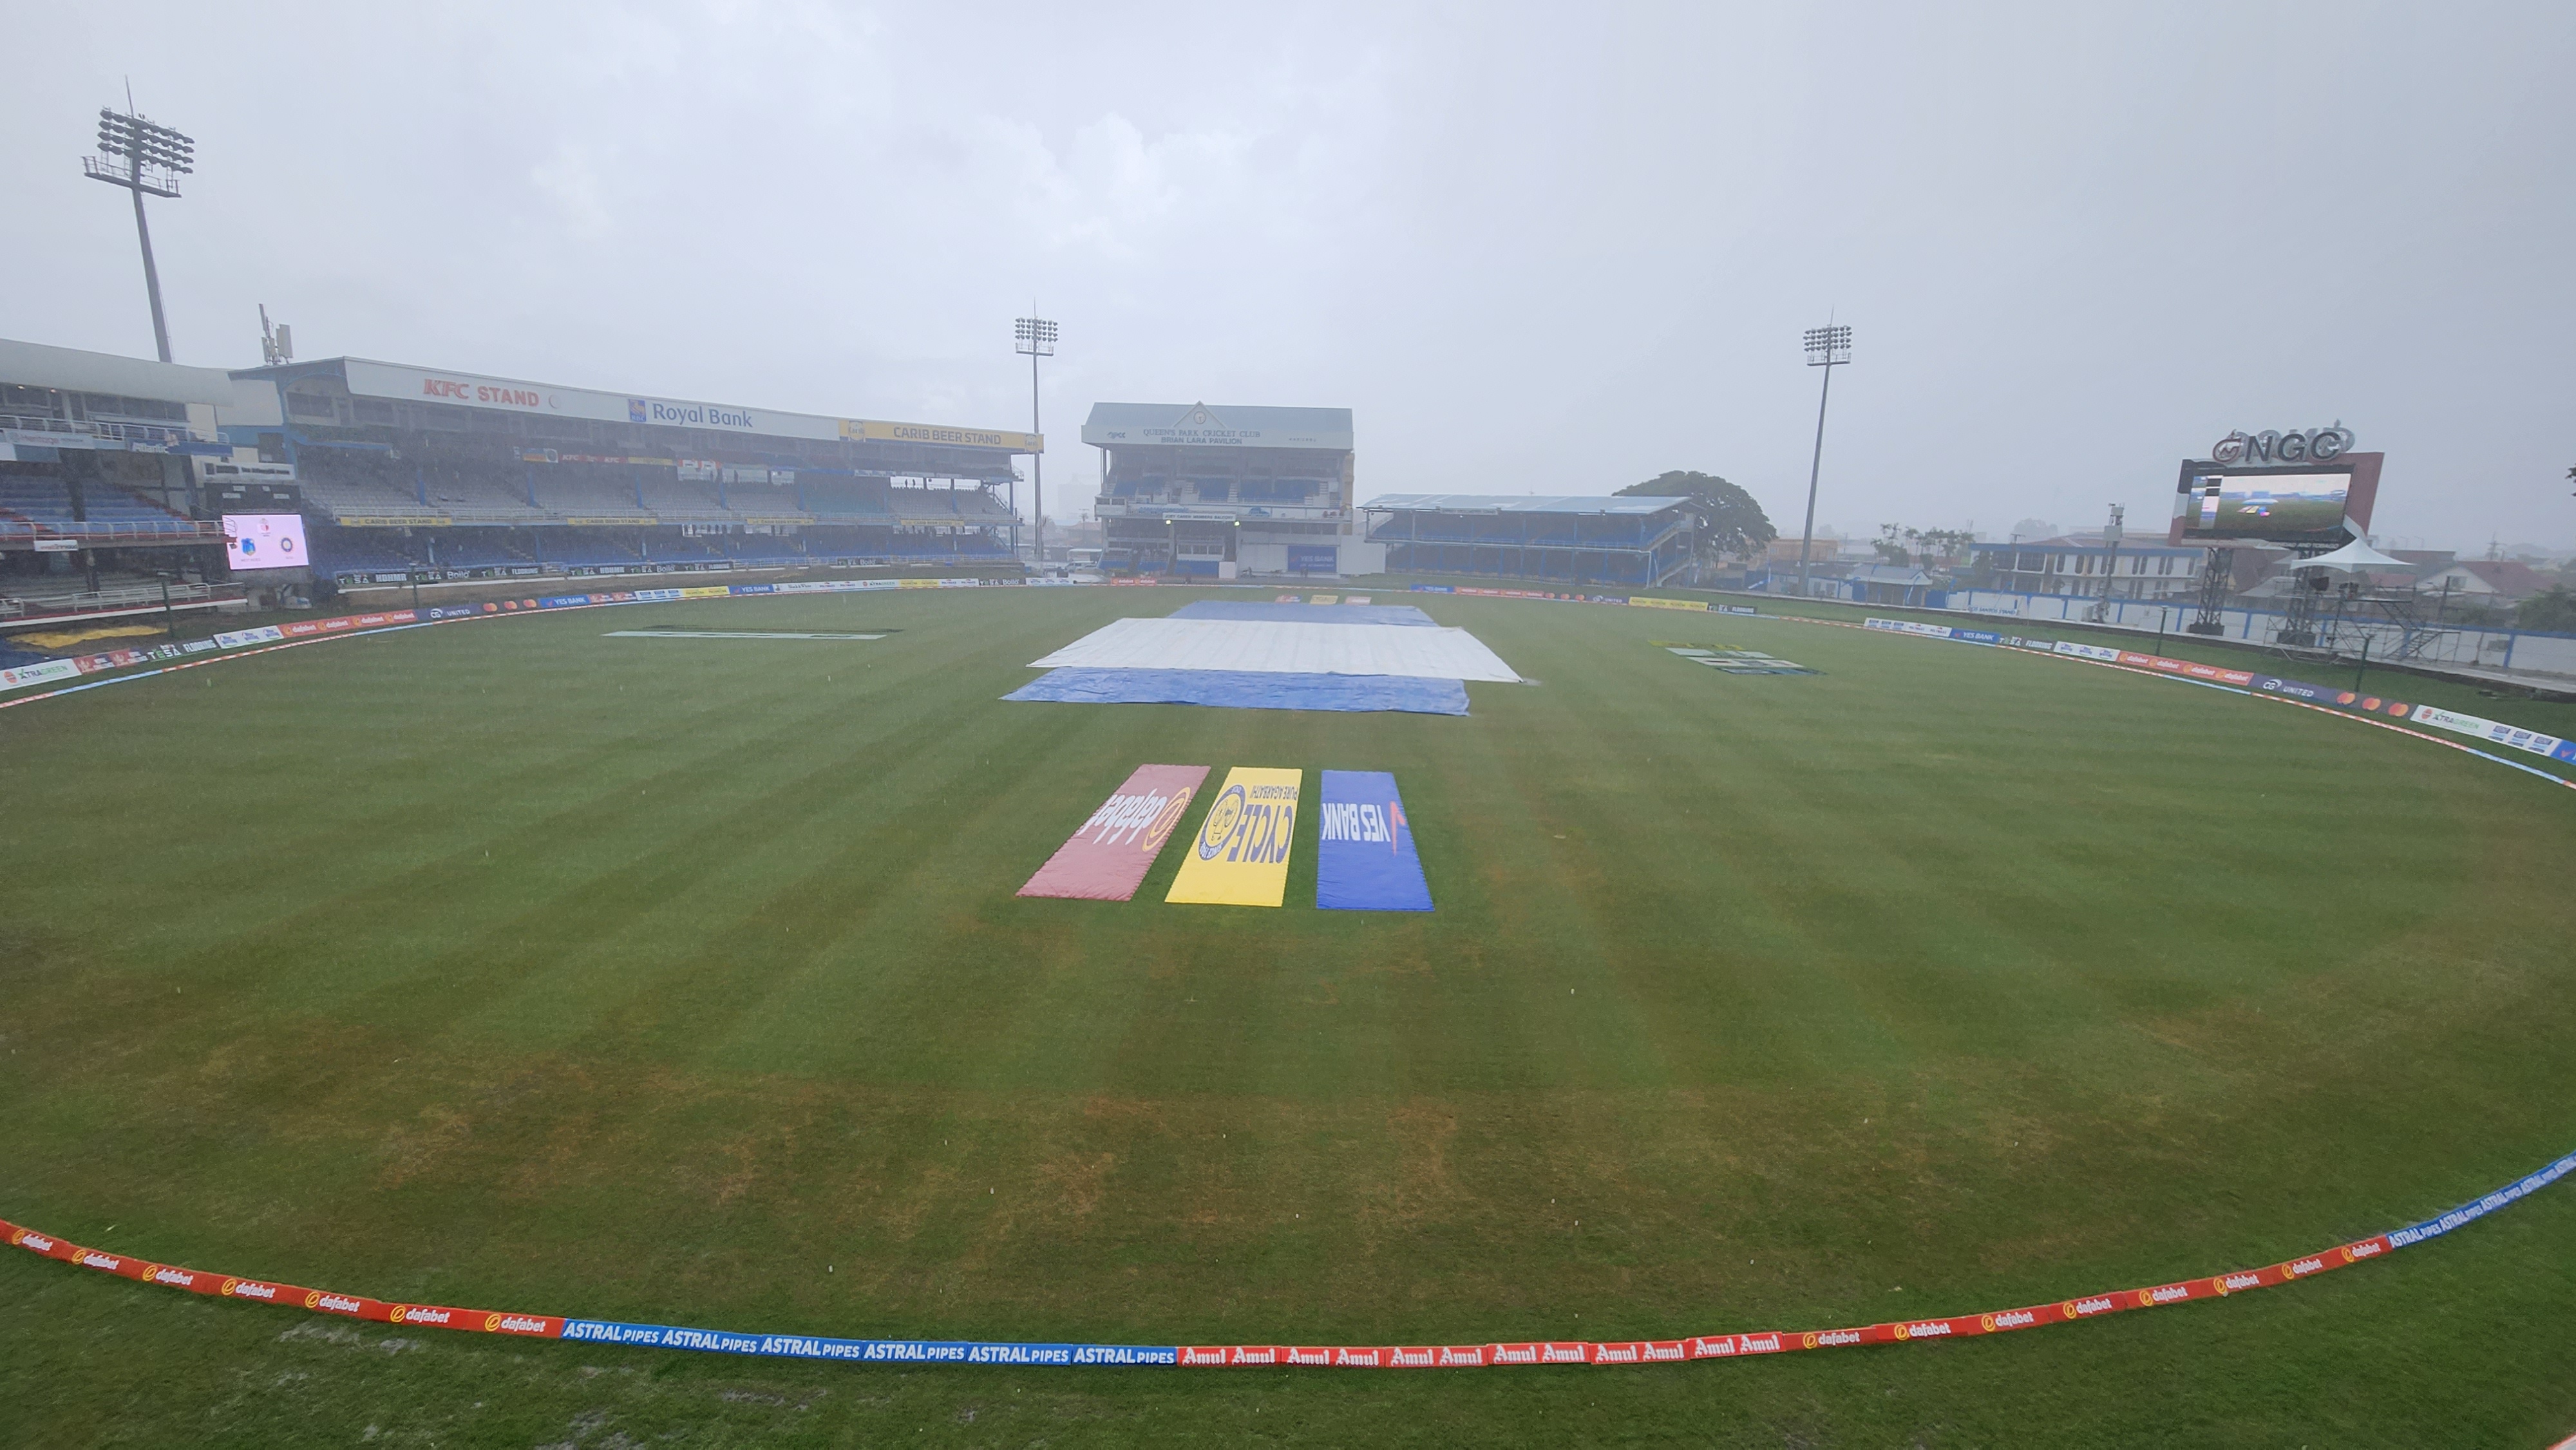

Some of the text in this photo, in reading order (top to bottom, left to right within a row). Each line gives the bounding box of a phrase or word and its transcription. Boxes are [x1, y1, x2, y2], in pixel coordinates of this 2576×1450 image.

[423, 378, 540, 407] KFC STAND
[652, 402, 753, 428] Royal Bank
[893, 426, 1001, 445] CARIB BEER STAND
[1143, 428, 1175, 437] QUEEN'S
[1202, 429, 1236, 438] CRICKET
[375, 573, 407, 583] HDHMR
[554, 597, 567, 605] YES
[326, 620, 348, 629] dafabet
[361, 616, 384, 625] dafabet
[393, 612, 415, 621] dafabet
[292, 625, 316, 634] dafabet
[1975, 632, 1995, 641] BANK
[183, 639, 216, 653] FLOORING
[2127, 655, 2149, 664] dafabet
[2157, 659, 2179, 669] dafabet
[18, 664, 68, 680] XTRAGREEN
[2192, 666, 2215, 676] dafabet
[2224, 672, 2249, 682] dafabet
[2263, 680, 2314, 697] CG UNITED
[2432, 711, 2479, 730] XTRAGREEN
[1250, 785, 1298, 801] PURE AGARBATHI
[1076, 788, 1167, 845] dafabet
[1322, 803, 1391, 842] YES BANK
[1226, 804, 1293, 863] CYCLE
[2520, 1174, 2545, 1194] ASTRAL
[2481, 1192, 2508, 1211] ASTRAL
[2439, 1211, 2468, 1231] ASTRAL
[23, 1234, 53, 1251] dafabet
[2389, 1228, 2423, 1248] ASTRAL
[2352, 1243, 2381, 1257] dafabet
[84, 1253, 119, 1270] dafabet
[2293, 1259, 2323, 1275] dafabet
[156, 1268, 193, 1286] dafabet
[2226, 1274, 2259, 1289] dafabet
[236, 1282, 276, 1299] dafabet
[2152, 1286, 2188, 1302] dafabet
[319, 1294, 361, 1312] dafabet
[2076, 1298, 2112, 1314] dafabet
[406, 1308, 450, 1324] dafabet
[501, 1316, 545, 1333] dafabet
[1996, 1312, 2034, 1327] dafabet
[563, 1322, 659, 1344] ASTRAL PIPES
[1909, 1322, 1951, 1337] dafabet
[661, 1330, 757, 1353] ASTRAL PIPES
[1694, 1337, 1735, 1358] Amul
[1739, 1333, 1781, 1354] Amul
[1818, 1332, 1860, 1346] dafabet
[761, 1337, 860, 1359] ASTRAL PIPES
[864, 1343, 965, 1360] ASTRAL PIPES
[968, 1346, 1069, 1363] ASTRAL PIPES
[1073, 1346, 1175, 1364] ASTRAL PIPES
[1182, 1346, 1226, 1366] Amul
[1232, 1346, 1276, 1365] Amul
[1287, 1347, 1330, 1366] Amul
[1336, 1347, 1379, 1366] Amul
[1390, 1346, 1434, 1366] Amul
[1439, 1346, 1483, 1366] Amul
[1493, 1344, 1537, 1364] Amul
[1542, 1343, 1586, 1362] Amul
[1595, 1344, 1638, 1364] Amul
[1643, 1342, 1685, 1361] Amul
